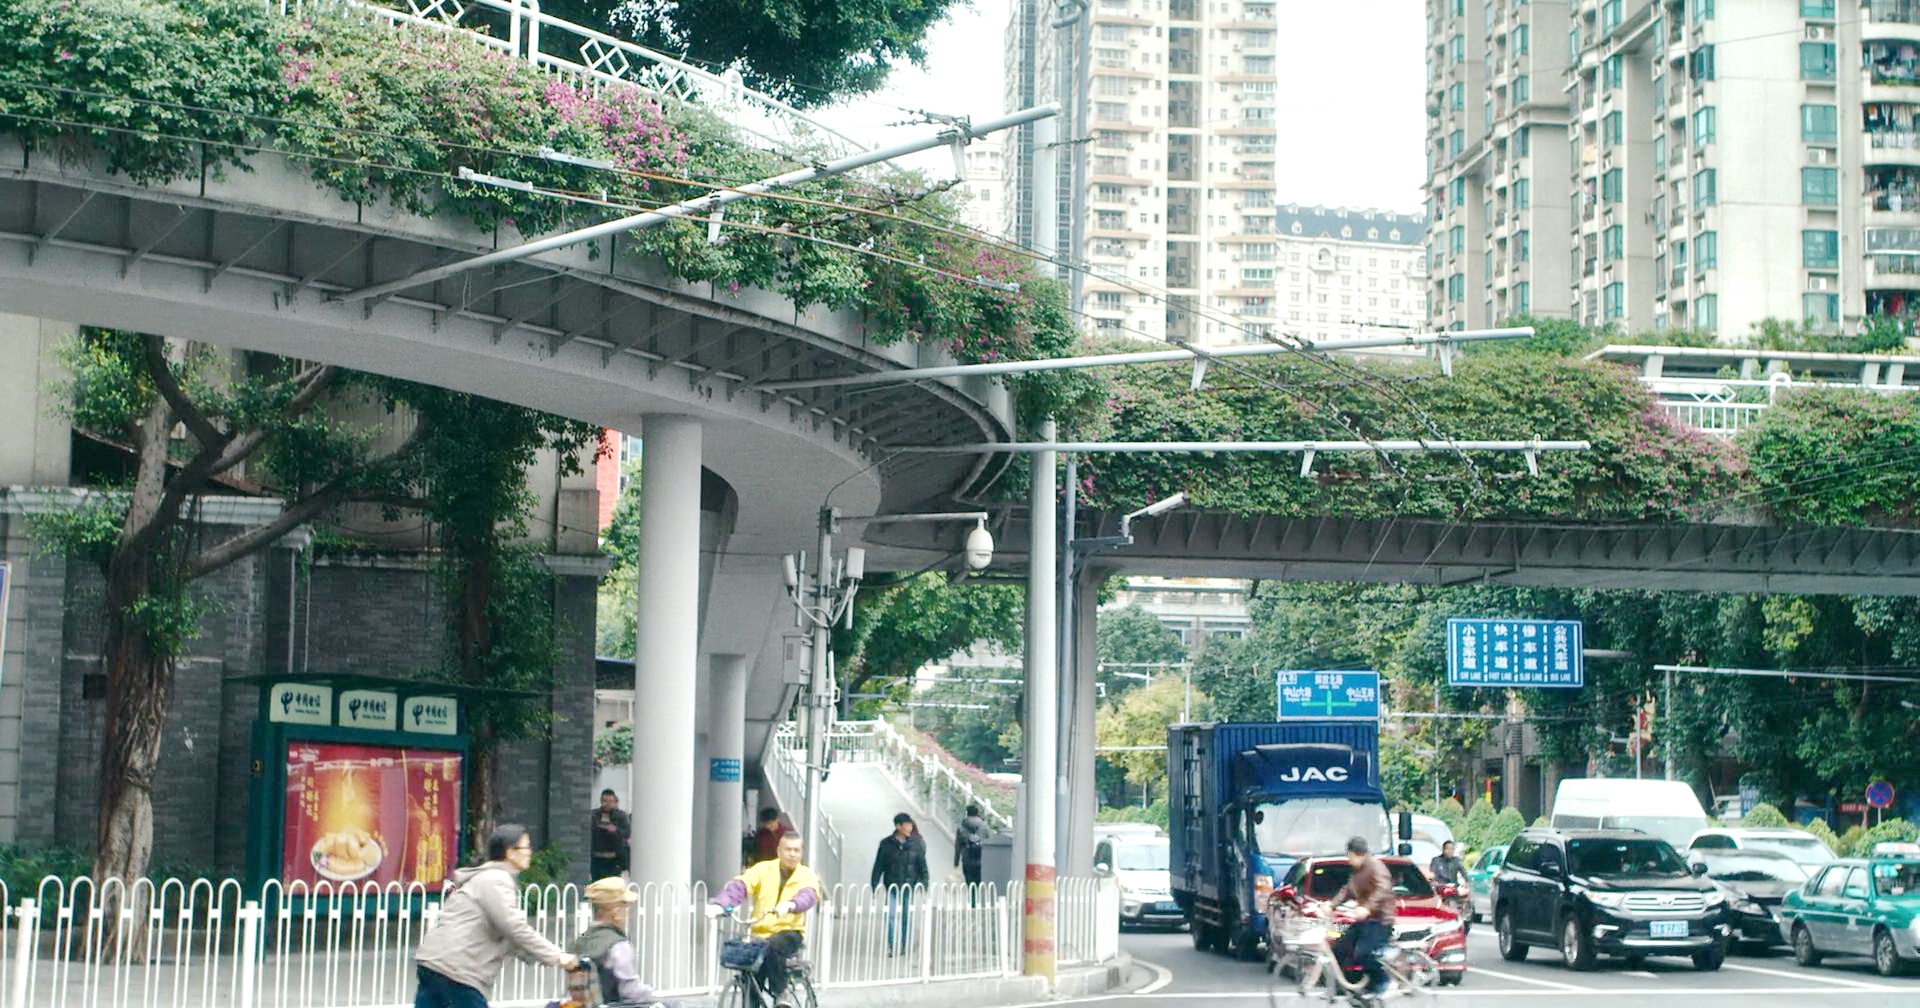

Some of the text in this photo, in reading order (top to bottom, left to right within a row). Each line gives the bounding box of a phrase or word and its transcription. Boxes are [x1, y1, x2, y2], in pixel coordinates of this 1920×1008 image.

[1462, 624, 1477, 669] 小客车道
[1494, 624, 1508, 669] 快车道
[1522, 625, 1537, 670] 慢车道
[1553, 625, 1568, 670] 公共汽车道
[1280, 767, 1348, 782] JAC
